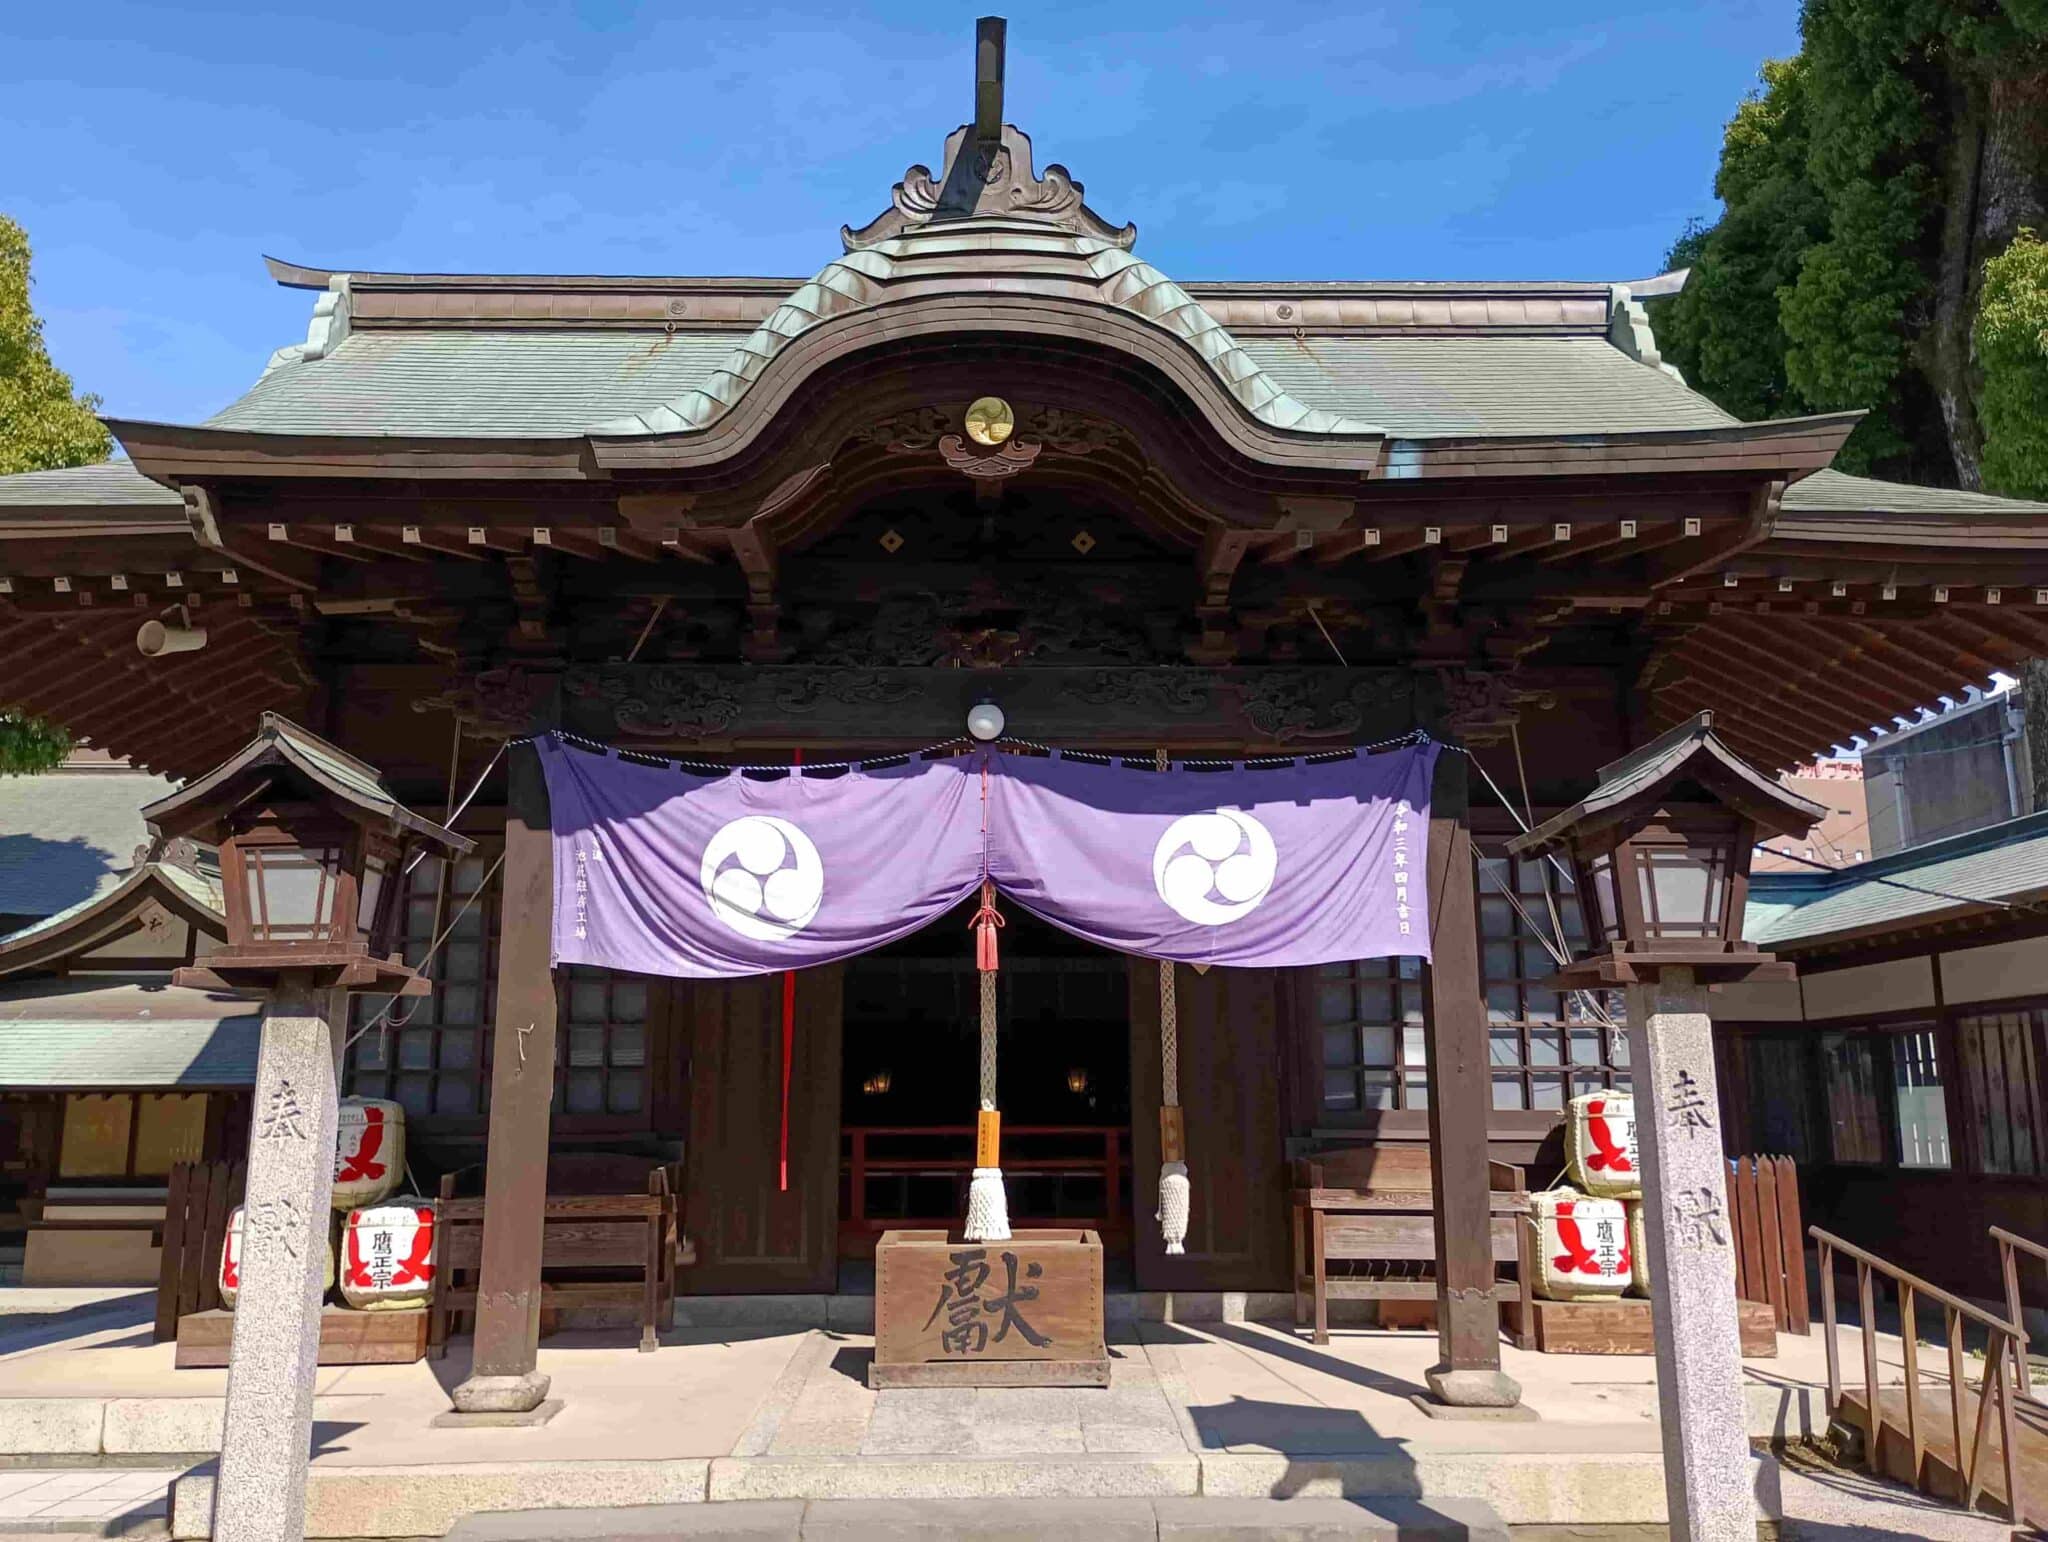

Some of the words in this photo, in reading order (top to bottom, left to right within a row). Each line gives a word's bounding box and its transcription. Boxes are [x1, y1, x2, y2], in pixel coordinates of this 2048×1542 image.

[1393, 802, 1412, 935] 令和三年四月吉日
[371, 1230, 394, 1290] 鷹正宗
[1596, 1219, 1617, 1278] 鷹正宗
